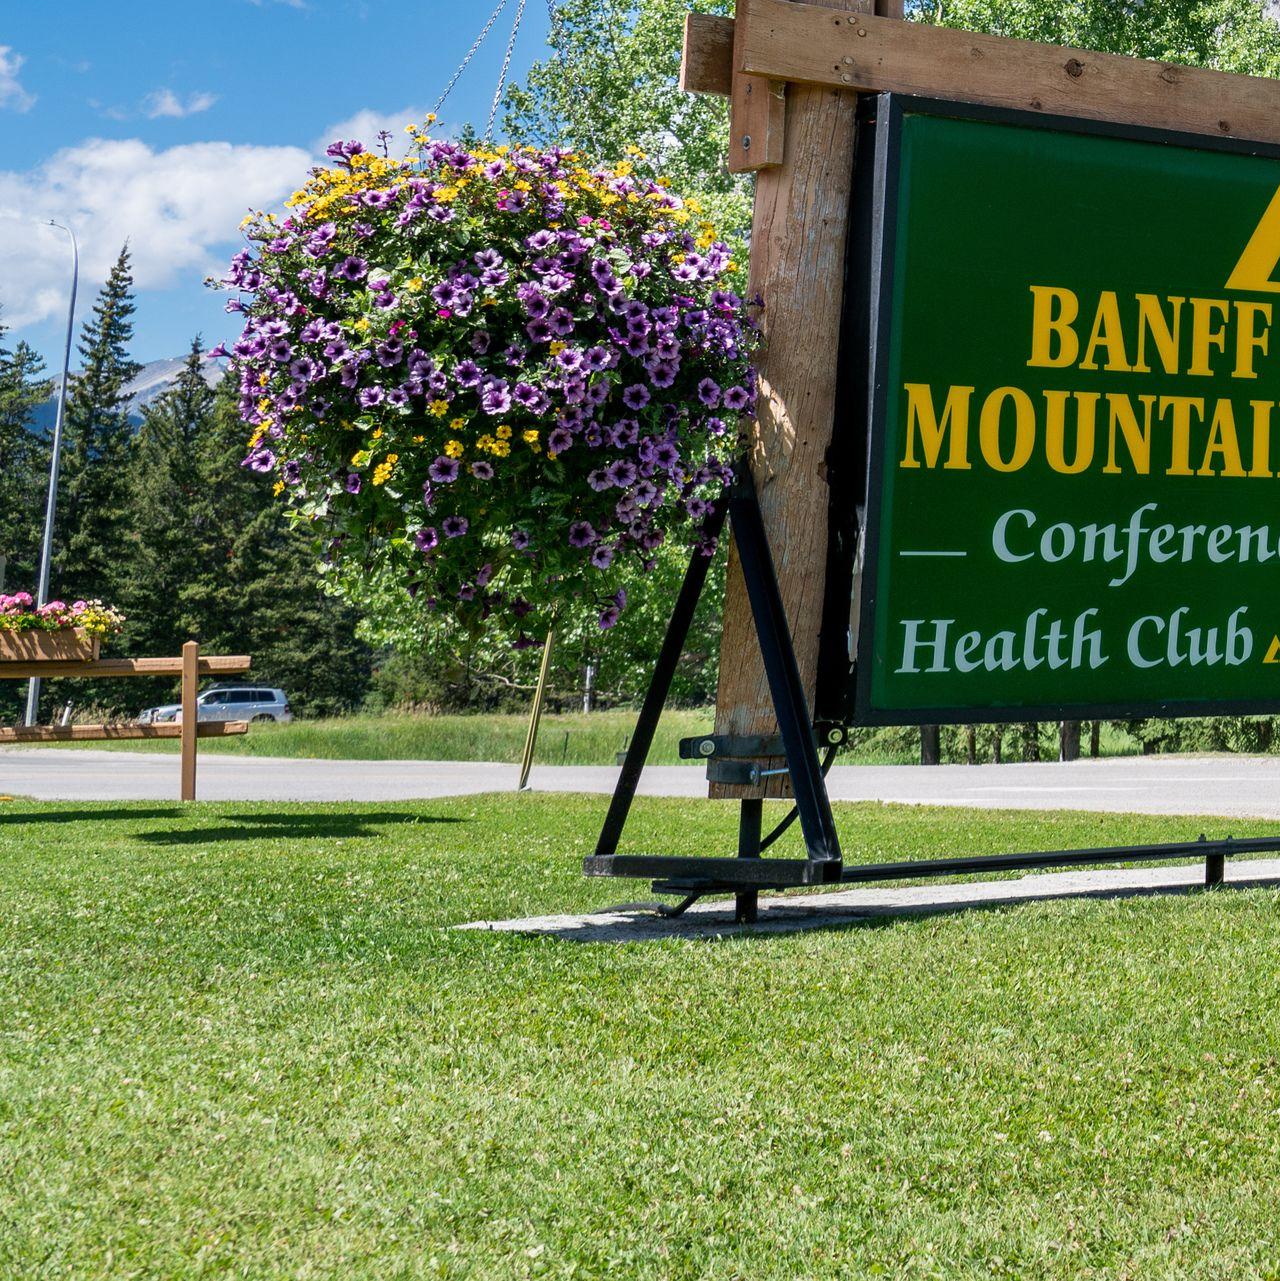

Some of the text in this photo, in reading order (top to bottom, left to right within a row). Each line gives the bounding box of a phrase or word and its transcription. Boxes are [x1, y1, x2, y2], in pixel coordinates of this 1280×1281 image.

[1026, 285, 1273, 379] BANFF
[894, 608, 1109, 674] Health
[1127, 606, 1254, 668] Club
